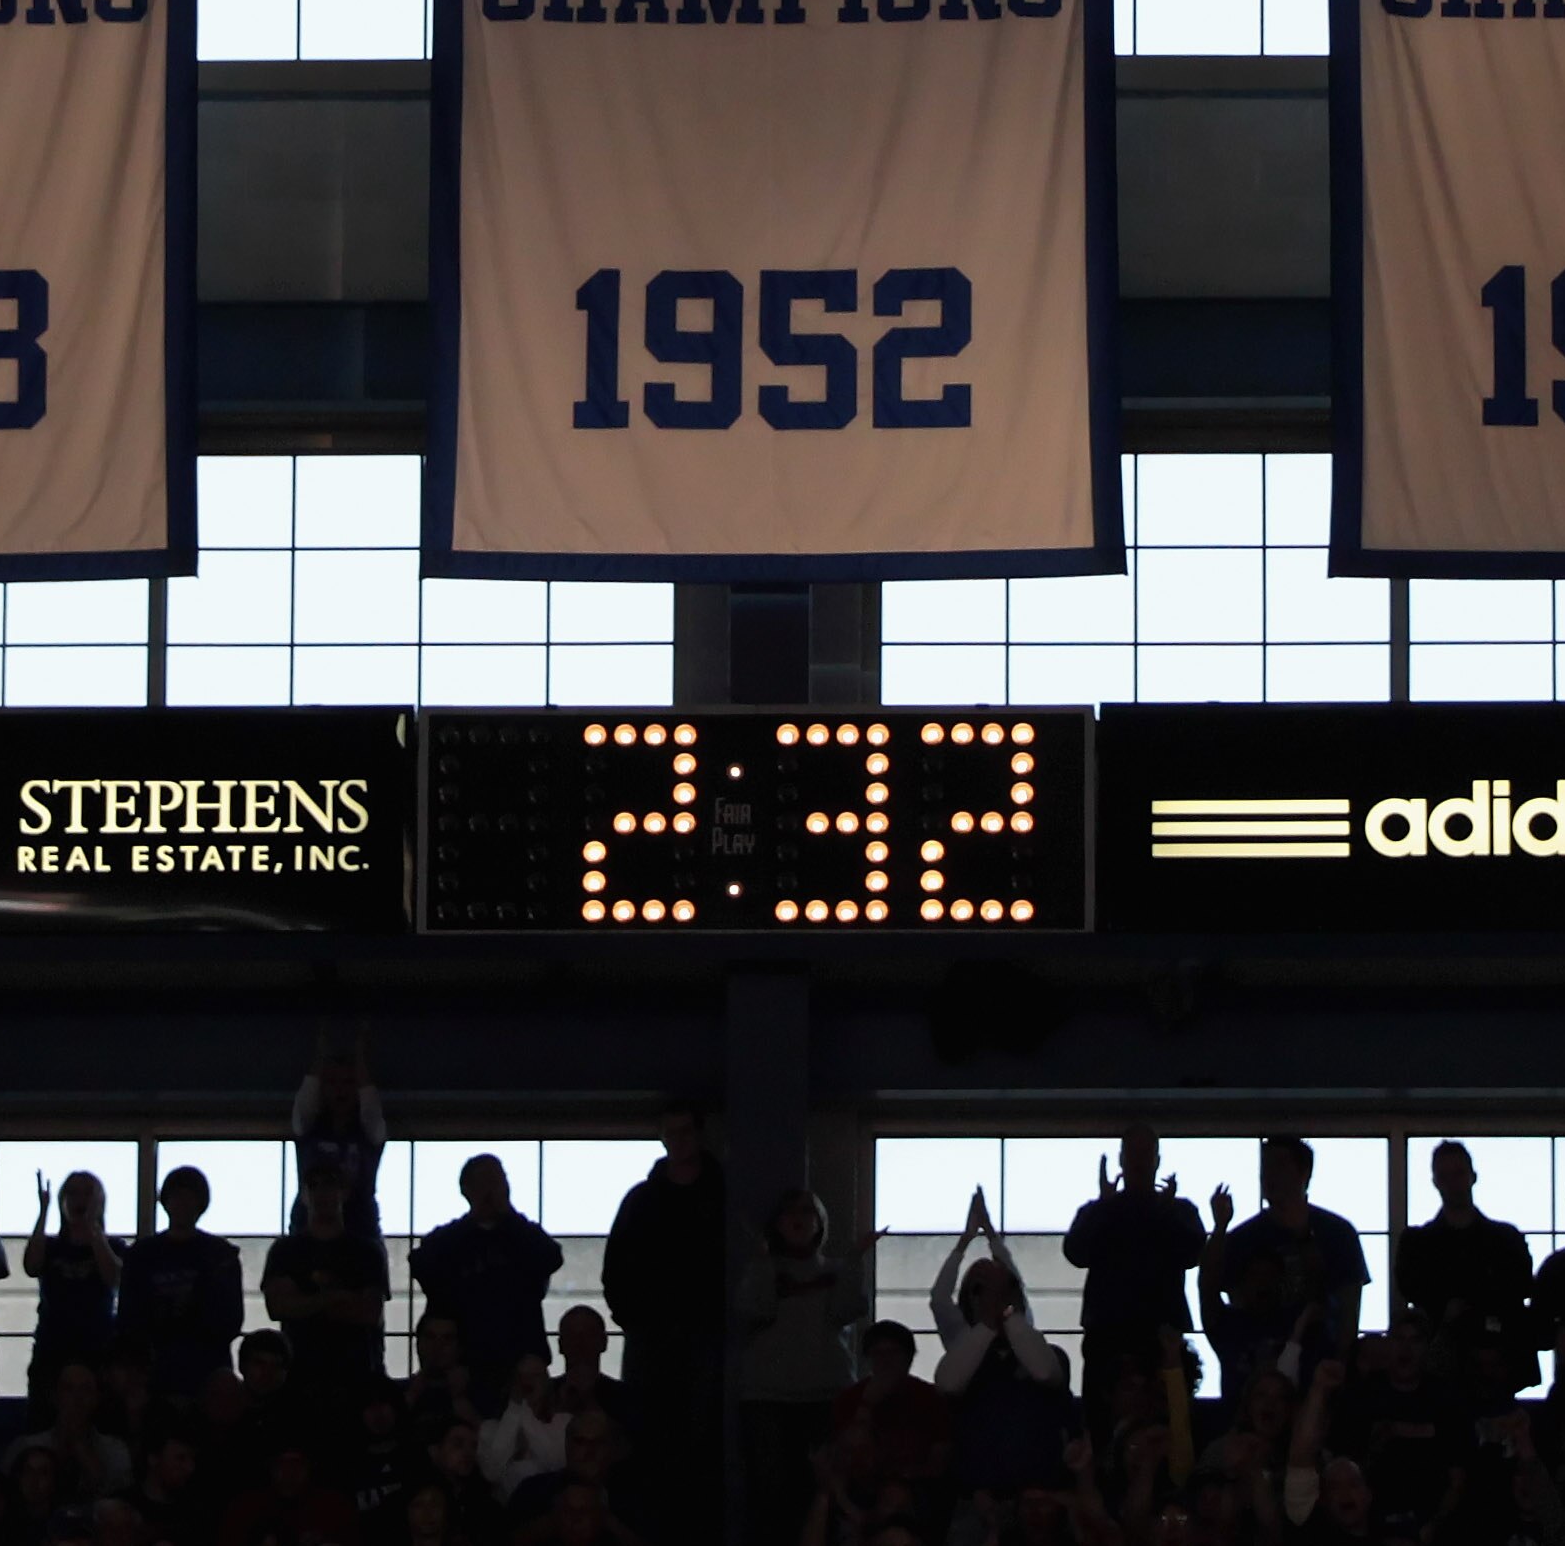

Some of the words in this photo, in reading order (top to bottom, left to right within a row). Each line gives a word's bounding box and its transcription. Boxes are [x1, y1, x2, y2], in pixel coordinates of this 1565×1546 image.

[573, 267, 972, 430] 1952
[16, 845, 116, 875] REAL
[130, 845, 288, 878] ESTATE,
[295, 844, 370, 873] INC.
[17, 779, 370, 835] STEPHENS
[581, 721, 1037, 924] 2:32
